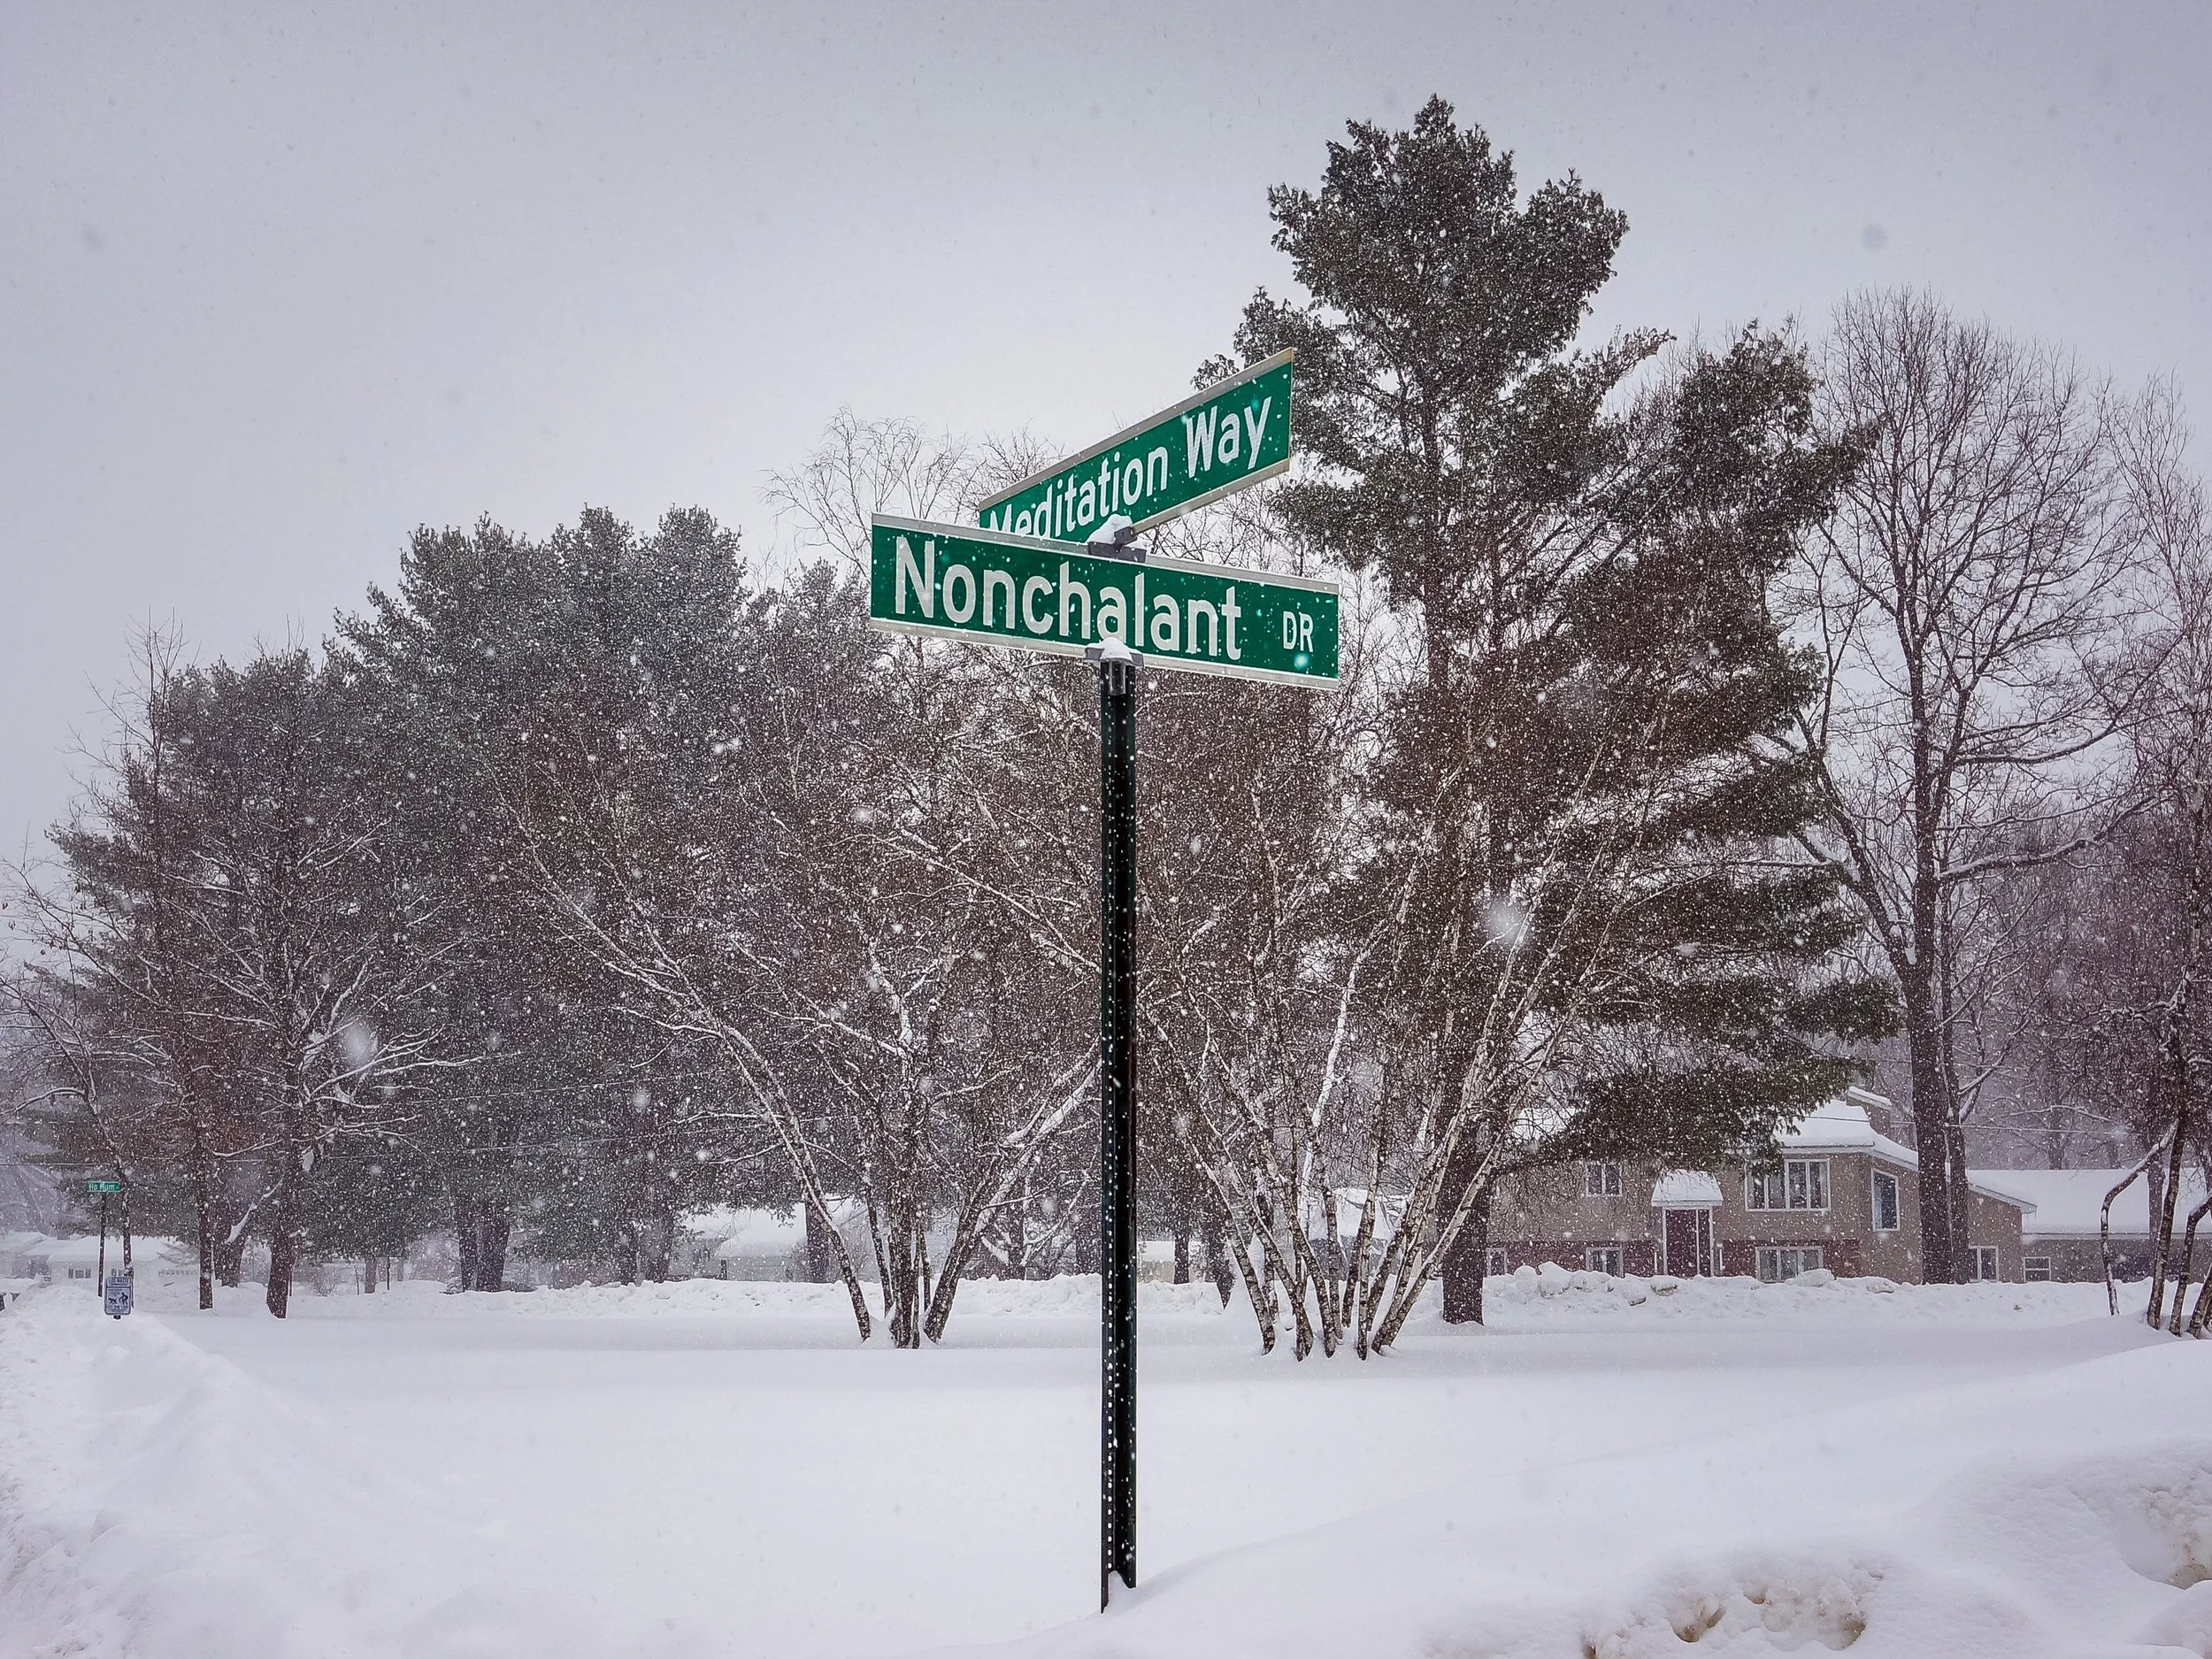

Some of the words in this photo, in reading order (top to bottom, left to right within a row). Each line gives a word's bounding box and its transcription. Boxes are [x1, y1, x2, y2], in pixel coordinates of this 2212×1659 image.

[1185, 396, 1272, 478] Way
[895, 537, 1241, 660] Nonchalant
[1283, 611, 1314, 653] DR
